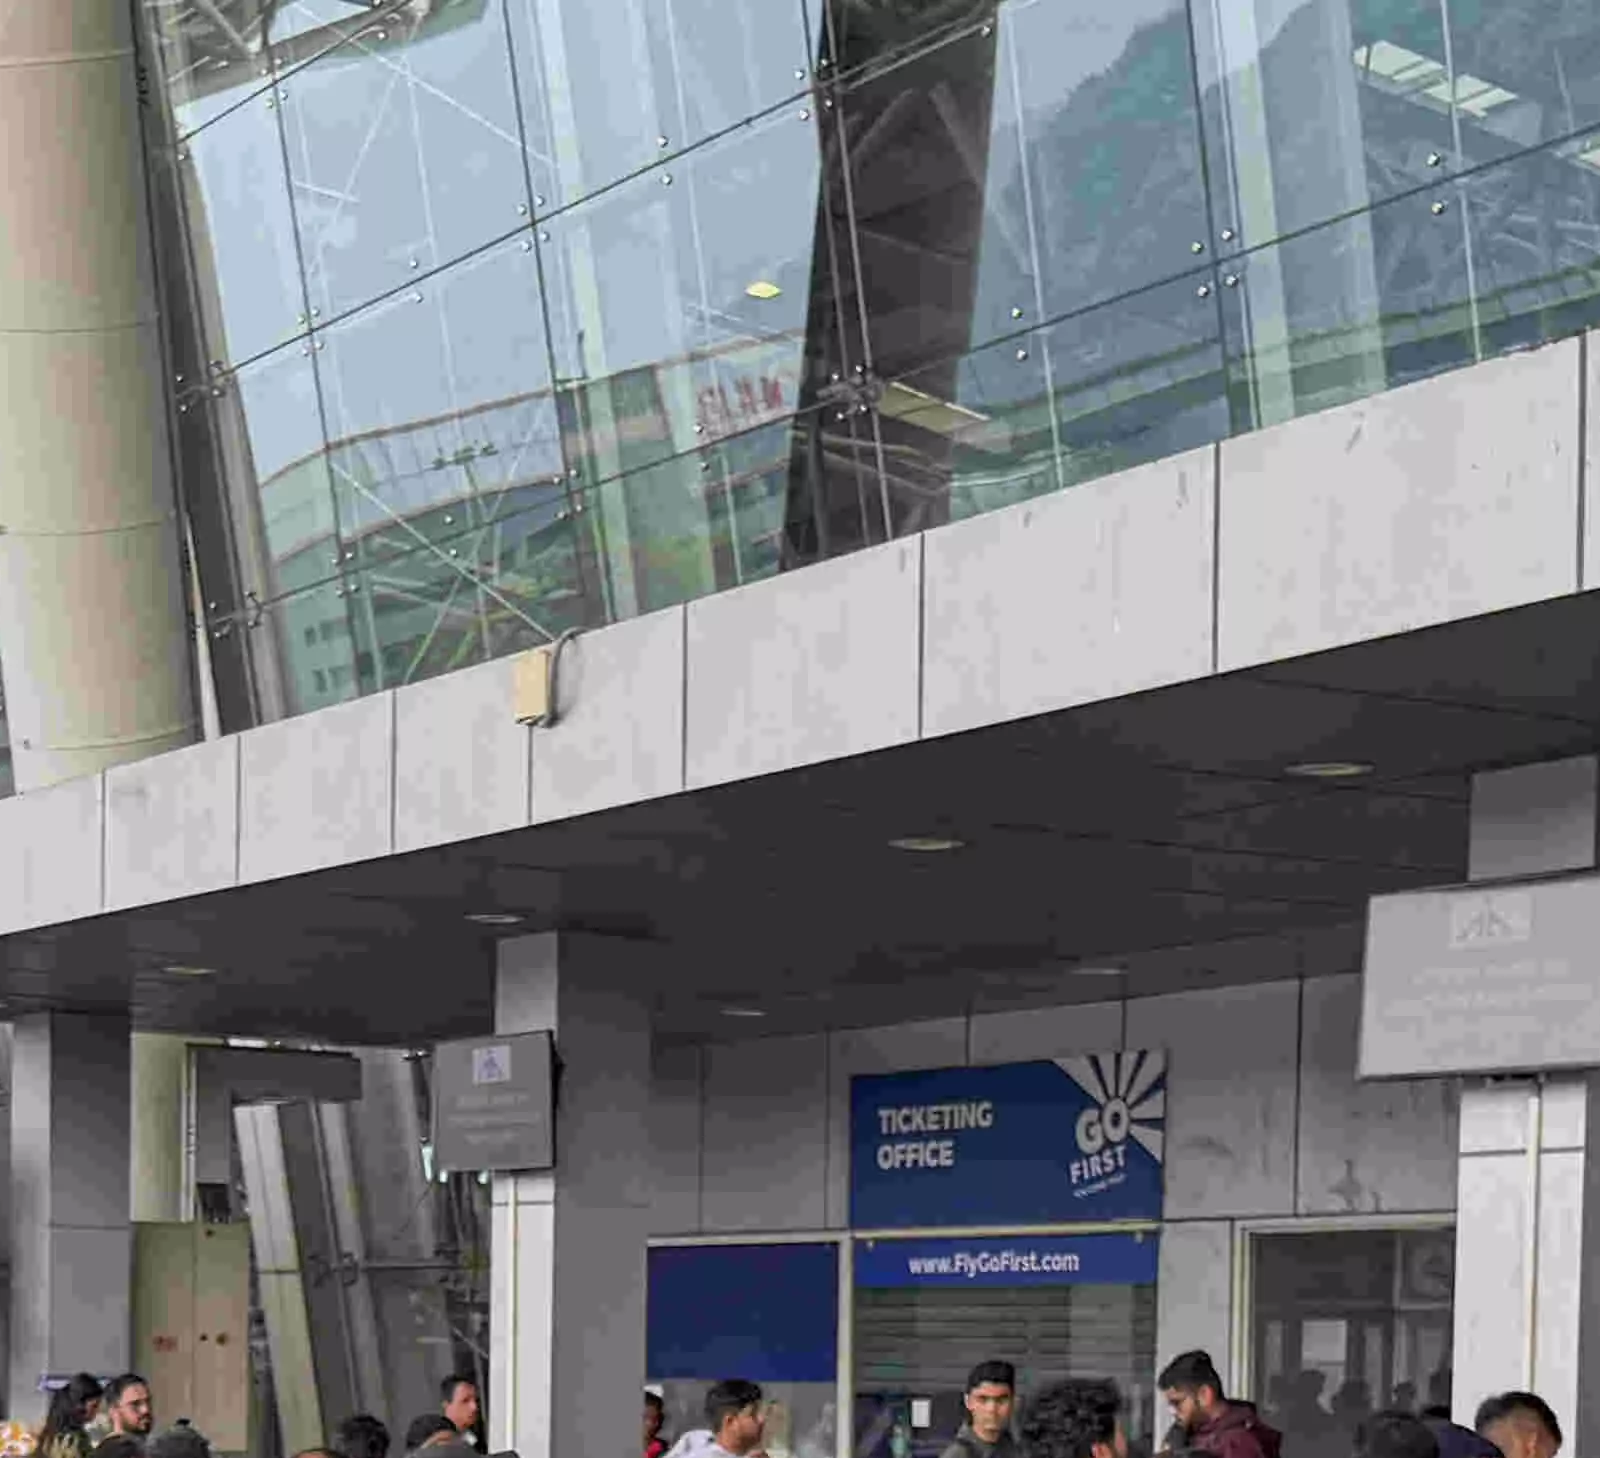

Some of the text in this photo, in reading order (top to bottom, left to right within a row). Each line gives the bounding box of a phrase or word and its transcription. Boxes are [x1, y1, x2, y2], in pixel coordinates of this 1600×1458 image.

[877, 1101, 993, 1135] TICKETING
[1074, 1098, 1130, 1155] GO
[876, 1139, 955, 1171] OFFICE
[1069, 1145, 1127, 1186] FIRST
[908, 1251, 1080, 1279] www.FlyGoFirst.com
